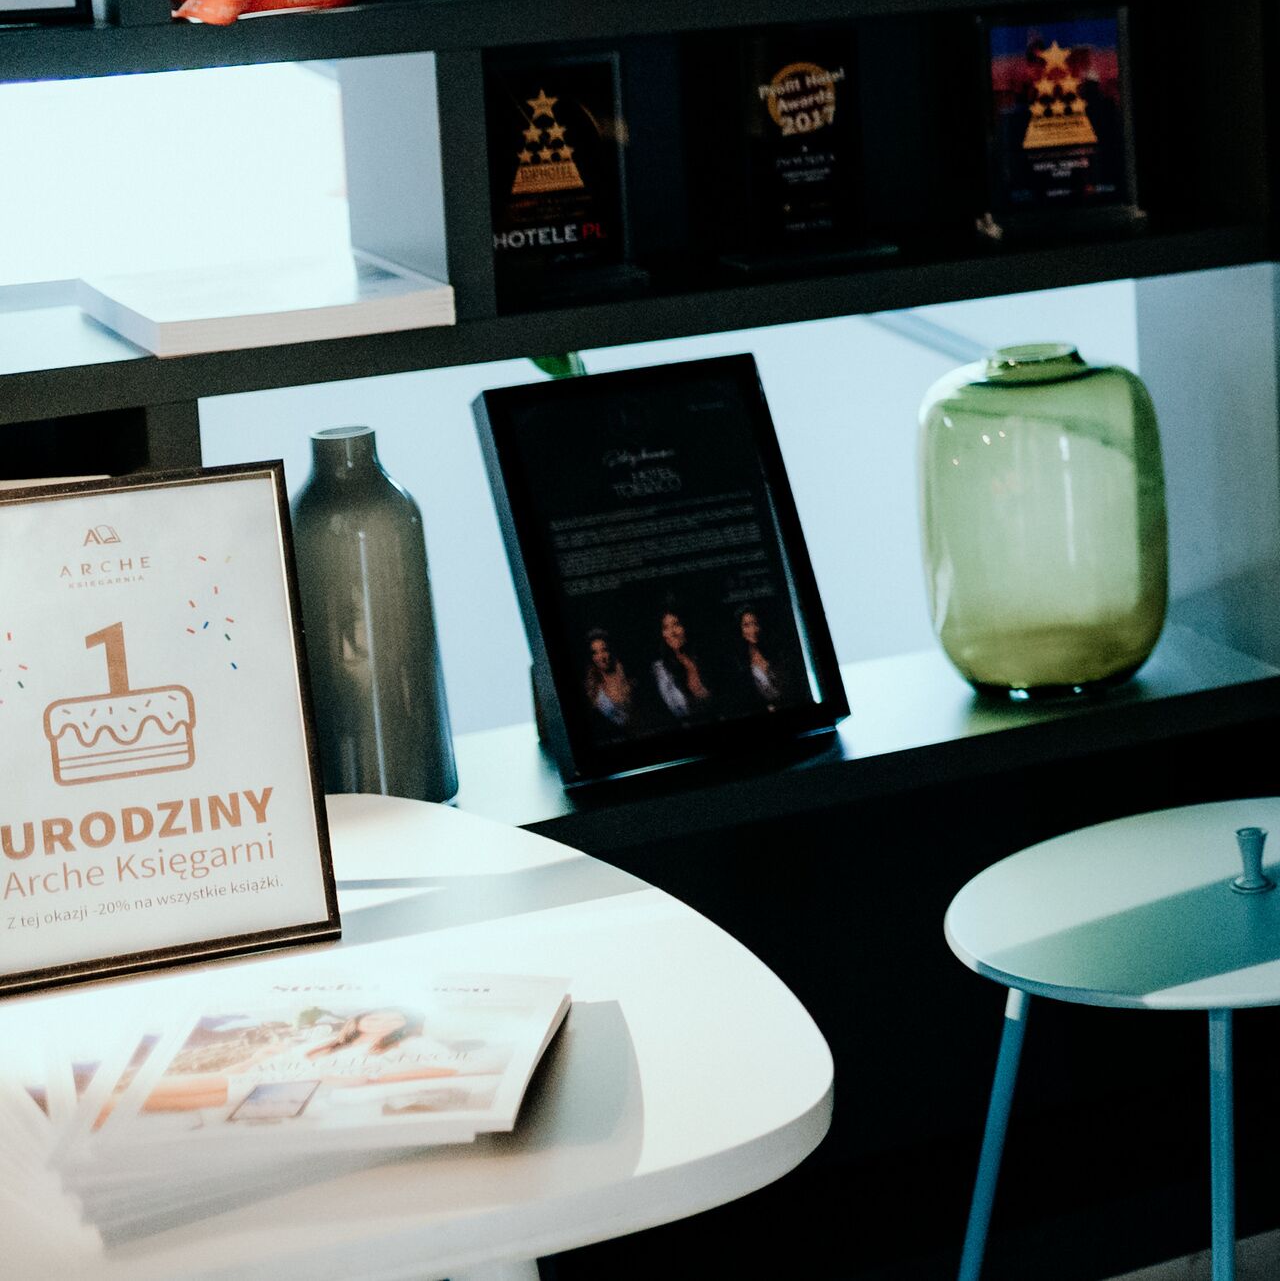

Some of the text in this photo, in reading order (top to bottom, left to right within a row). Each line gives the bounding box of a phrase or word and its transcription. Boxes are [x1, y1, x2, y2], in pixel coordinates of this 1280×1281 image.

[493, 223, 579, 251] HOTELE
[60, 556, 152, 578] ARCHE
[1, 787, 274, 861] URODZINY
[3, 832, 275, 901] Arche Księgarni
[44, 906, 89, 924] okazji
[93, 900, 131, 916] -20%
[134, 897, 153, 910] na
[156, 884, 227, 907] wszystkie
[230, 874, 284, 897] książki.
